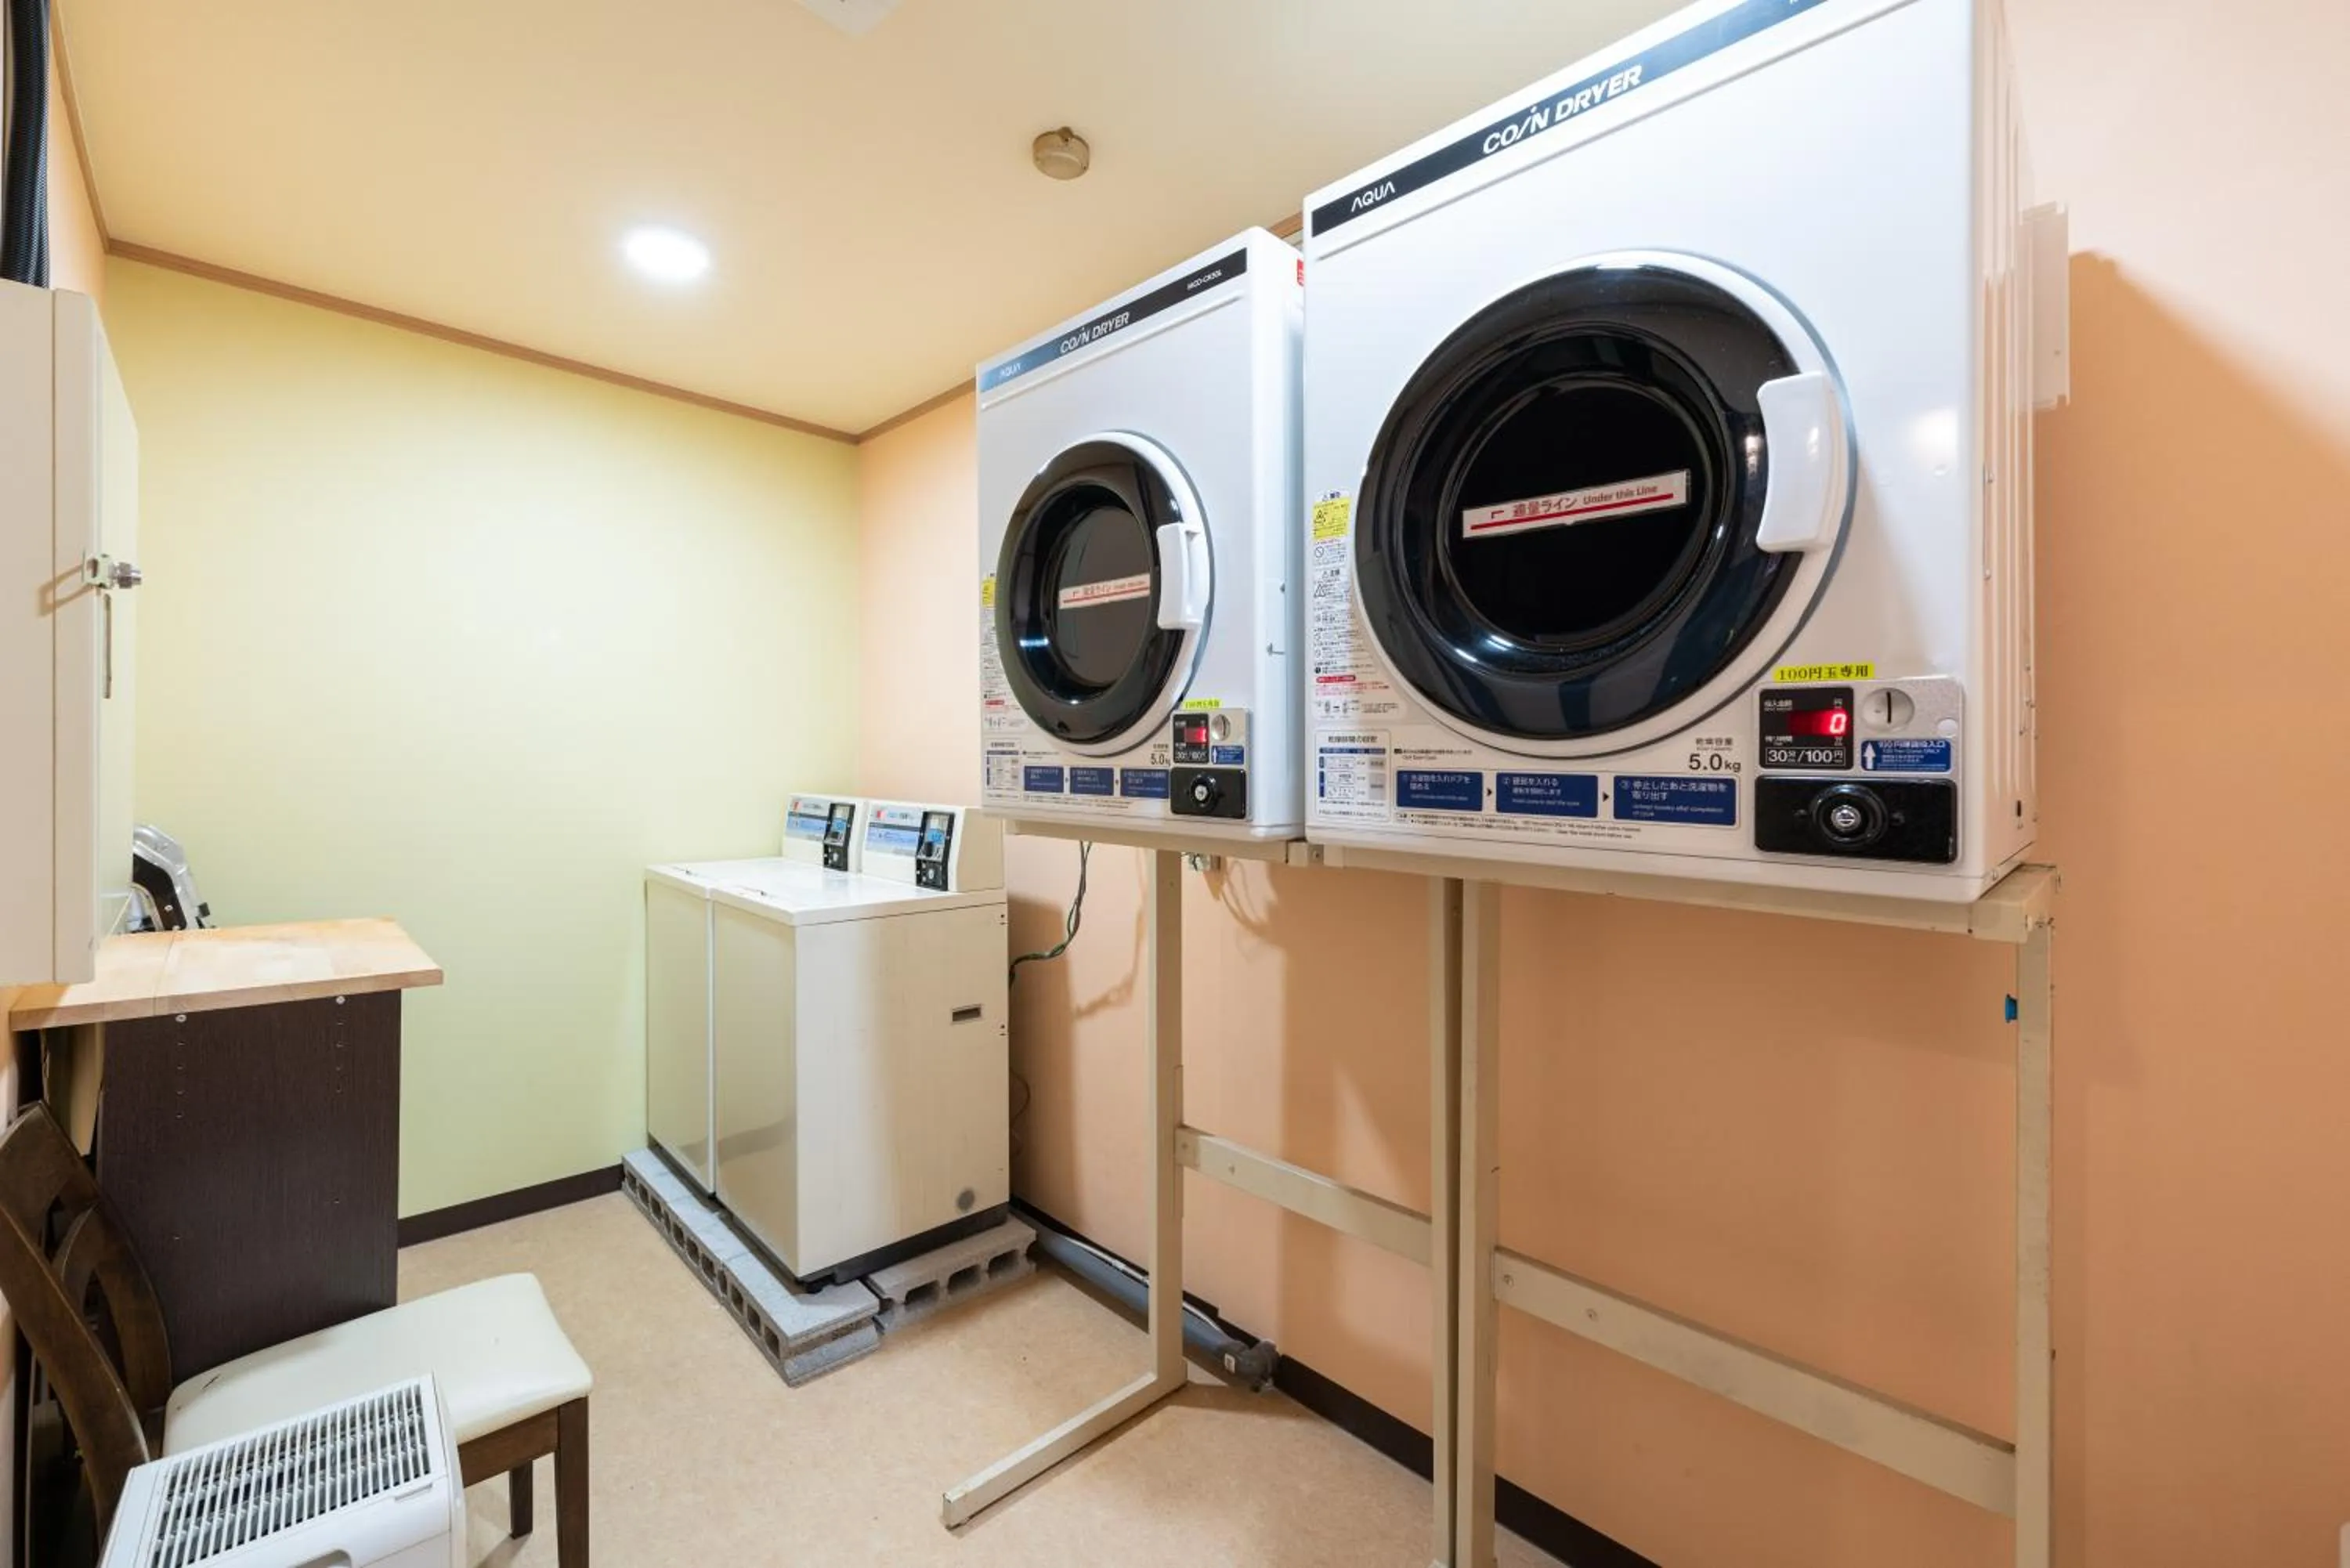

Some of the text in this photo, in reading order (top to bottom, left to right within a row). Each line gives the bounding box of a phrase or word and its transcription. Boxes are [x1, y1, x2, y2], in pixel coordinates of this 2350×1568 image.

[1554, 64, 1643, 122] DRYER
[1350, 181, 1395, 212] AQUA
[1092, 312, 1130, 339] DRYER
[1583, 492, 1613, 505] Under
[1616, 487, 1635, 500] this
[1636, 484, 1658, 497] Line
[1779, 664, 1869, 681] 100円玉専用
[1829, 714, 1847, 734] 0
